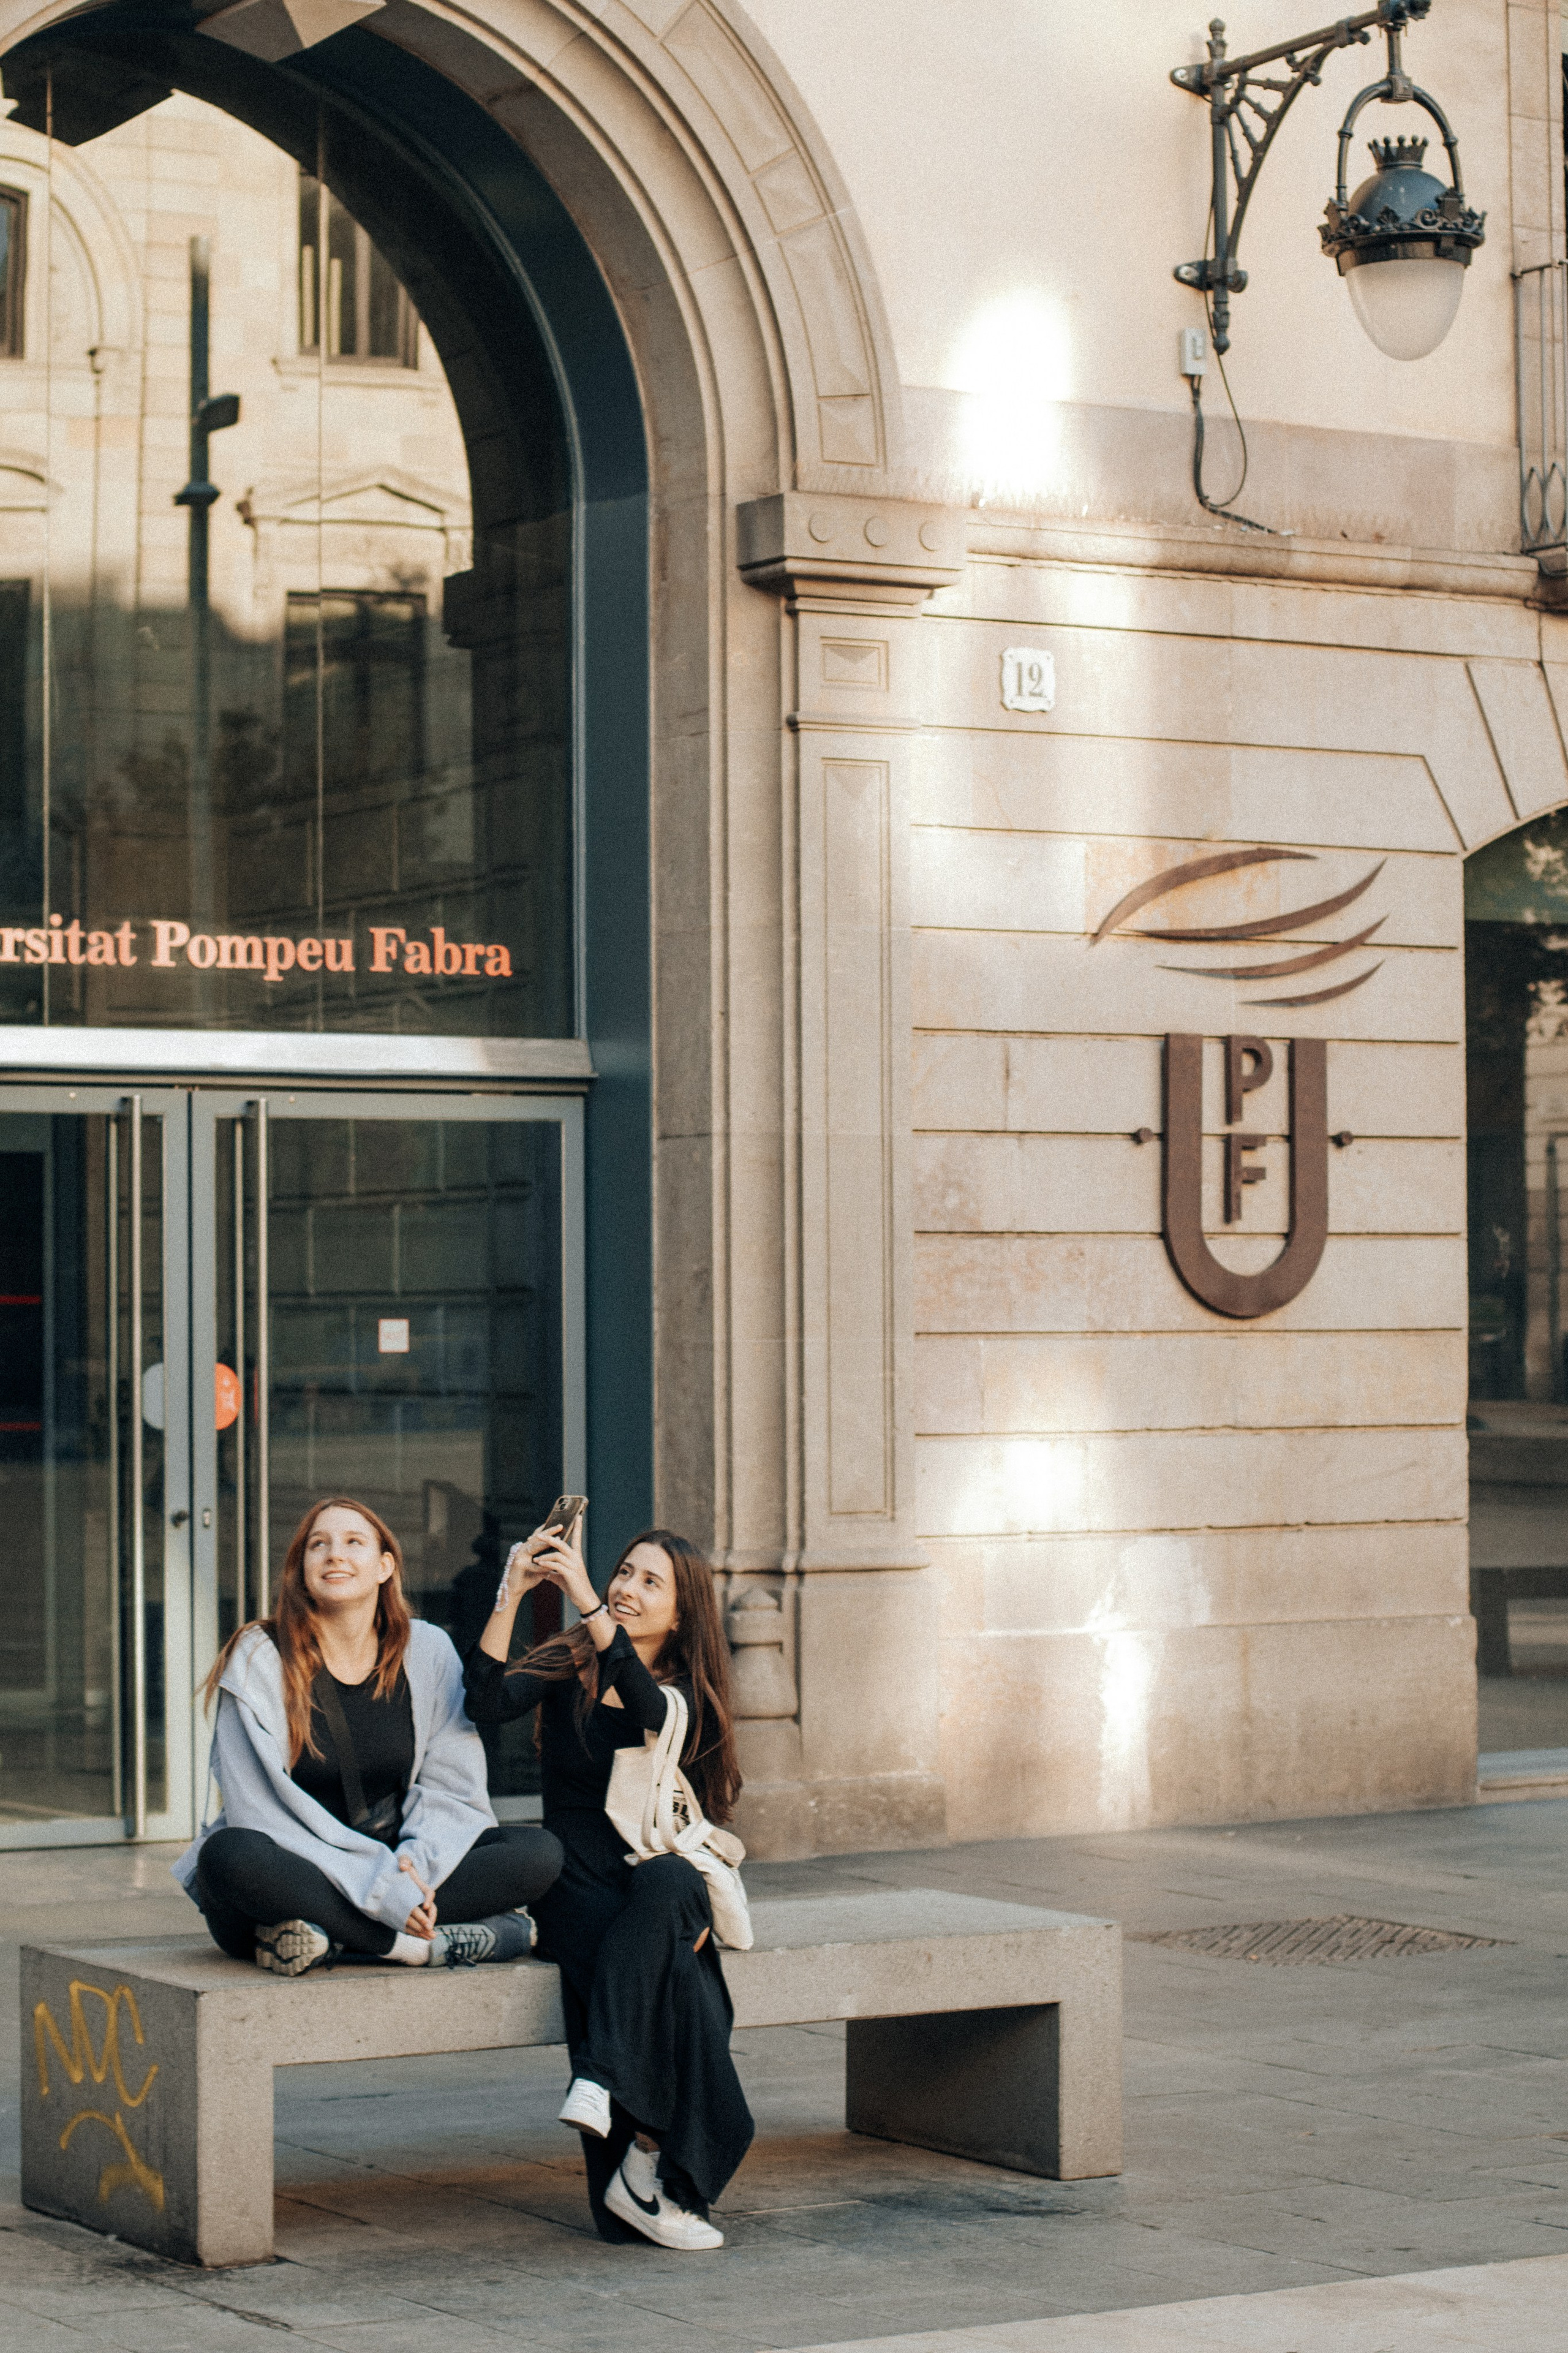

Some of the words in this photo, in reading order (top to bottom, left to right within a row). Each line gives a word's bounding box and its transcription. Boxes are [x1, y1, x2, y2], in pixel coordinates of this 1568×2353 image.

[1016, 662, 1047, 698] 12
[151, 920, 356, 981] Pompeu
[369, 927, 513, 976] Fabra
